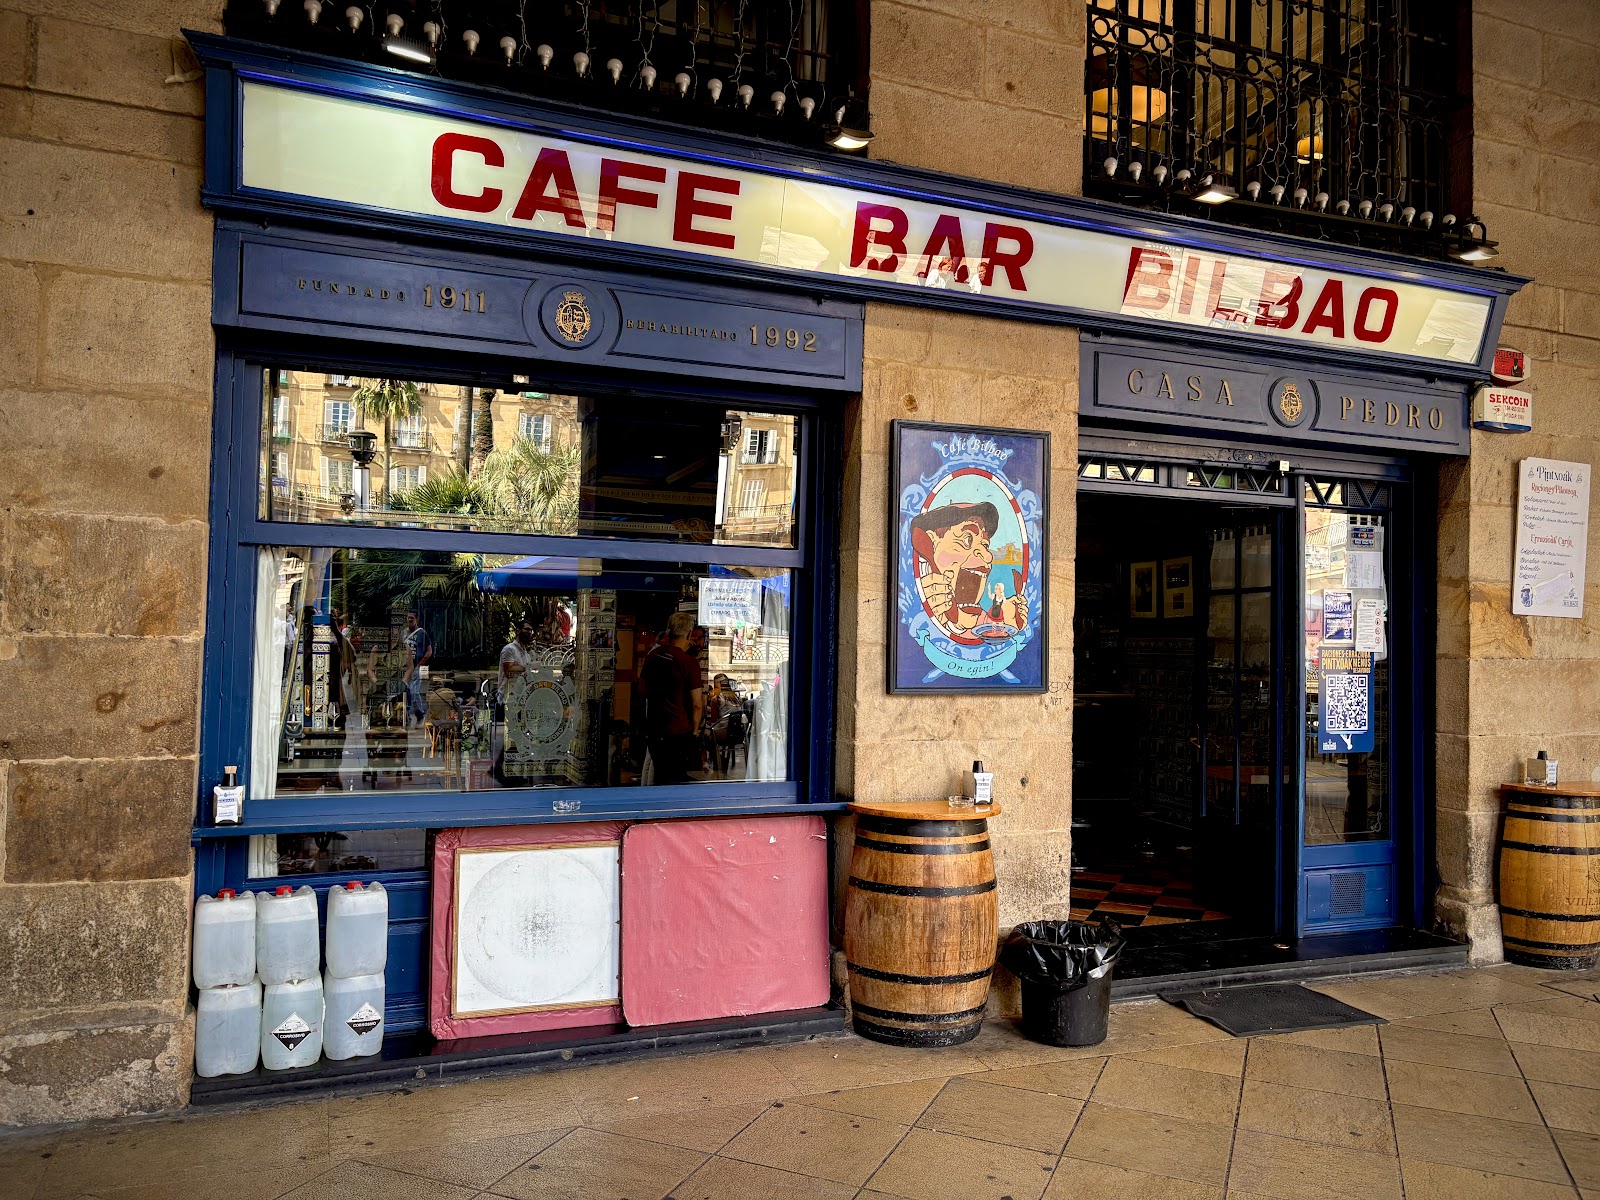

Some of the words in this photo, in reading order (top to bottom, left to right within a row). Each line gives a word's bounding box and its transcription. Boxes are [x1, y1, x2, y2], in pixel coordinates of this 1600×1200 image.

[430, 131, 743, 251] CAFE
[848, 200, 1035, 293] BAR
[1122, 244, 1401, 344] BILBAO
[296, 278, 408, 302] FUNDADO
[423, 283, 487, 315] 1911
[625, 318, 738, 342] REHABILITADO
[748, 323, 818, 353] 1992
[1127, 368, 1236, 408] CASA
[1339, 394, 1444, 432] PEDRO
[941, 438, 967, 459] Café
[970, 438, 1009, 461] Bilbao
[947, 660, 964, 672] On
